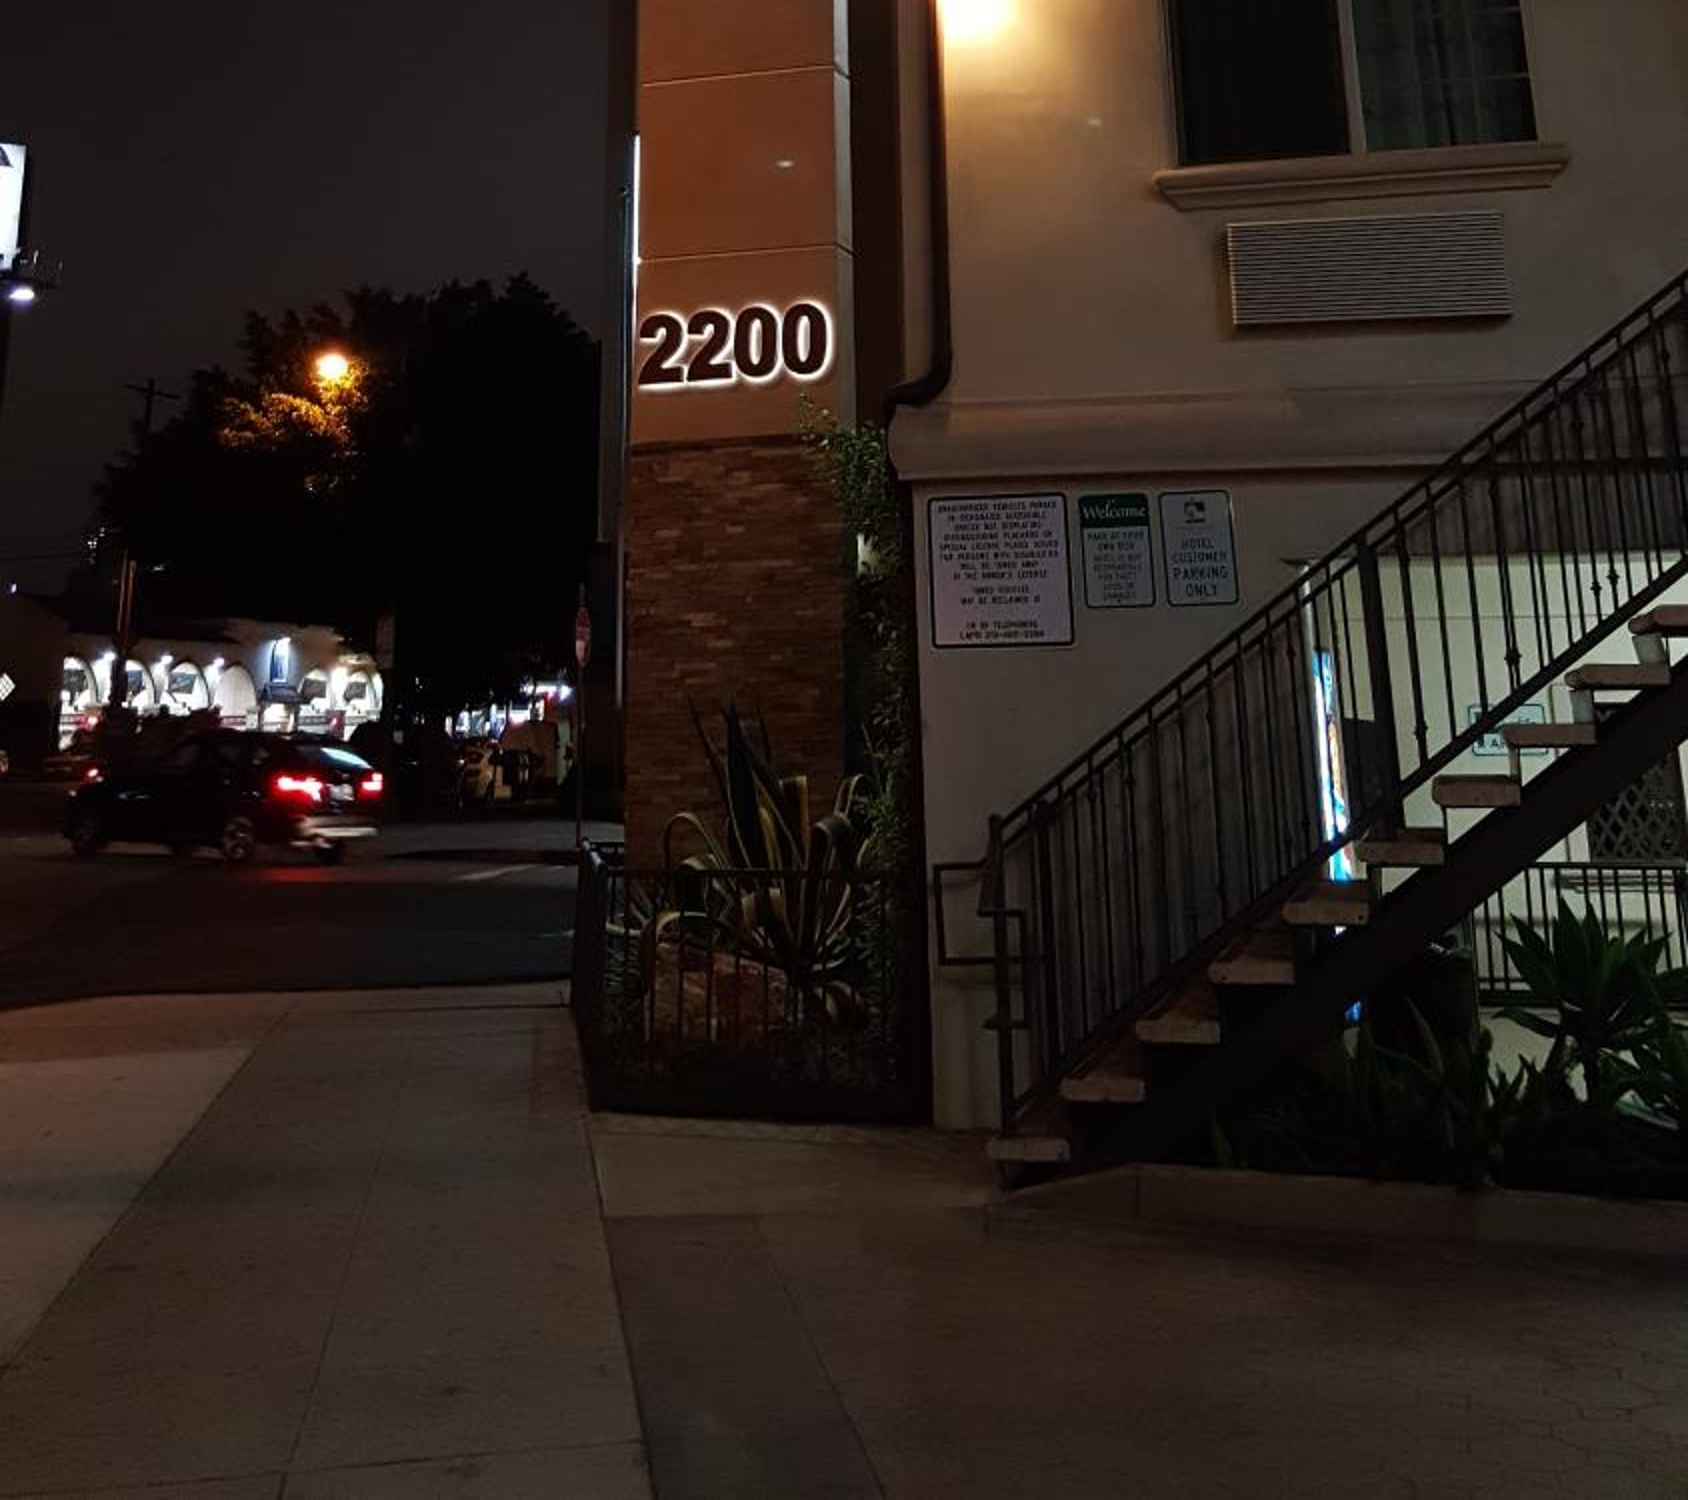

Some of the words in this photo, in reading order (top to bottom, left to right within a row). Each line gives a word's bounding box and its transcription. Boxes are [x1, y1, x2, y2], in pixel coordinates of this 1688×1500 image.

[638, 302, 831, 387] 2200
[1083, 500, 1147, 519] Welcome
[1173, 565, 1229, 581] PARKING
[1185, 583, 1217, 596] ONLY
